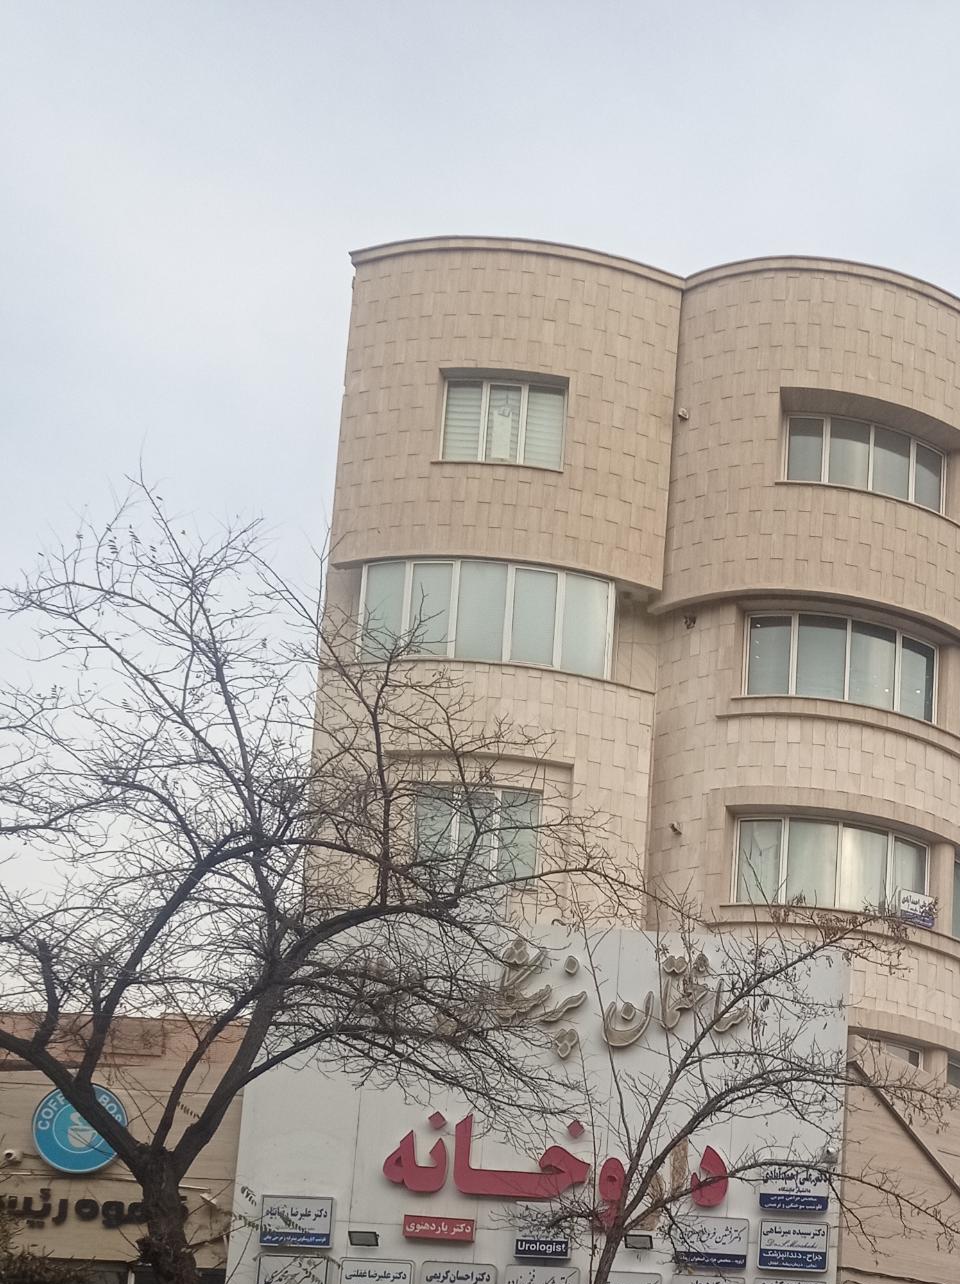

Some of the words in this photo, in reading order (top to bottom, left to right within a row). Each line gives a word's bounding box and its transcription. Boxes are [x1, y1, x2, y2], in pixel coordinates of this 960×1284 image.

[74, 1195, 189, 1229] هوه
[290, 1206, 311, 1221] علیرضا
[313, 1207, 328, 1221] دکتر
[451, 1223, 472, 1236] دکتر
[728, 1226, 747, 1244] دکتر
[810, 1228, 826, 1239] دکتر
[518, 1241, 566, 1254] Urologist
[762, 1250, 802, 1260] دندانپزشک
[806, 1252, 823, 1262] جراح
[368, 1270, 391, 1282] علیرضا
[391, 1271, 407, 1282] دکتر
[425, 1270, 450, 1283] کریمی
[449, 1269, 474, 1283] احسان
[473, 1271, 491, 1284] دکتر
